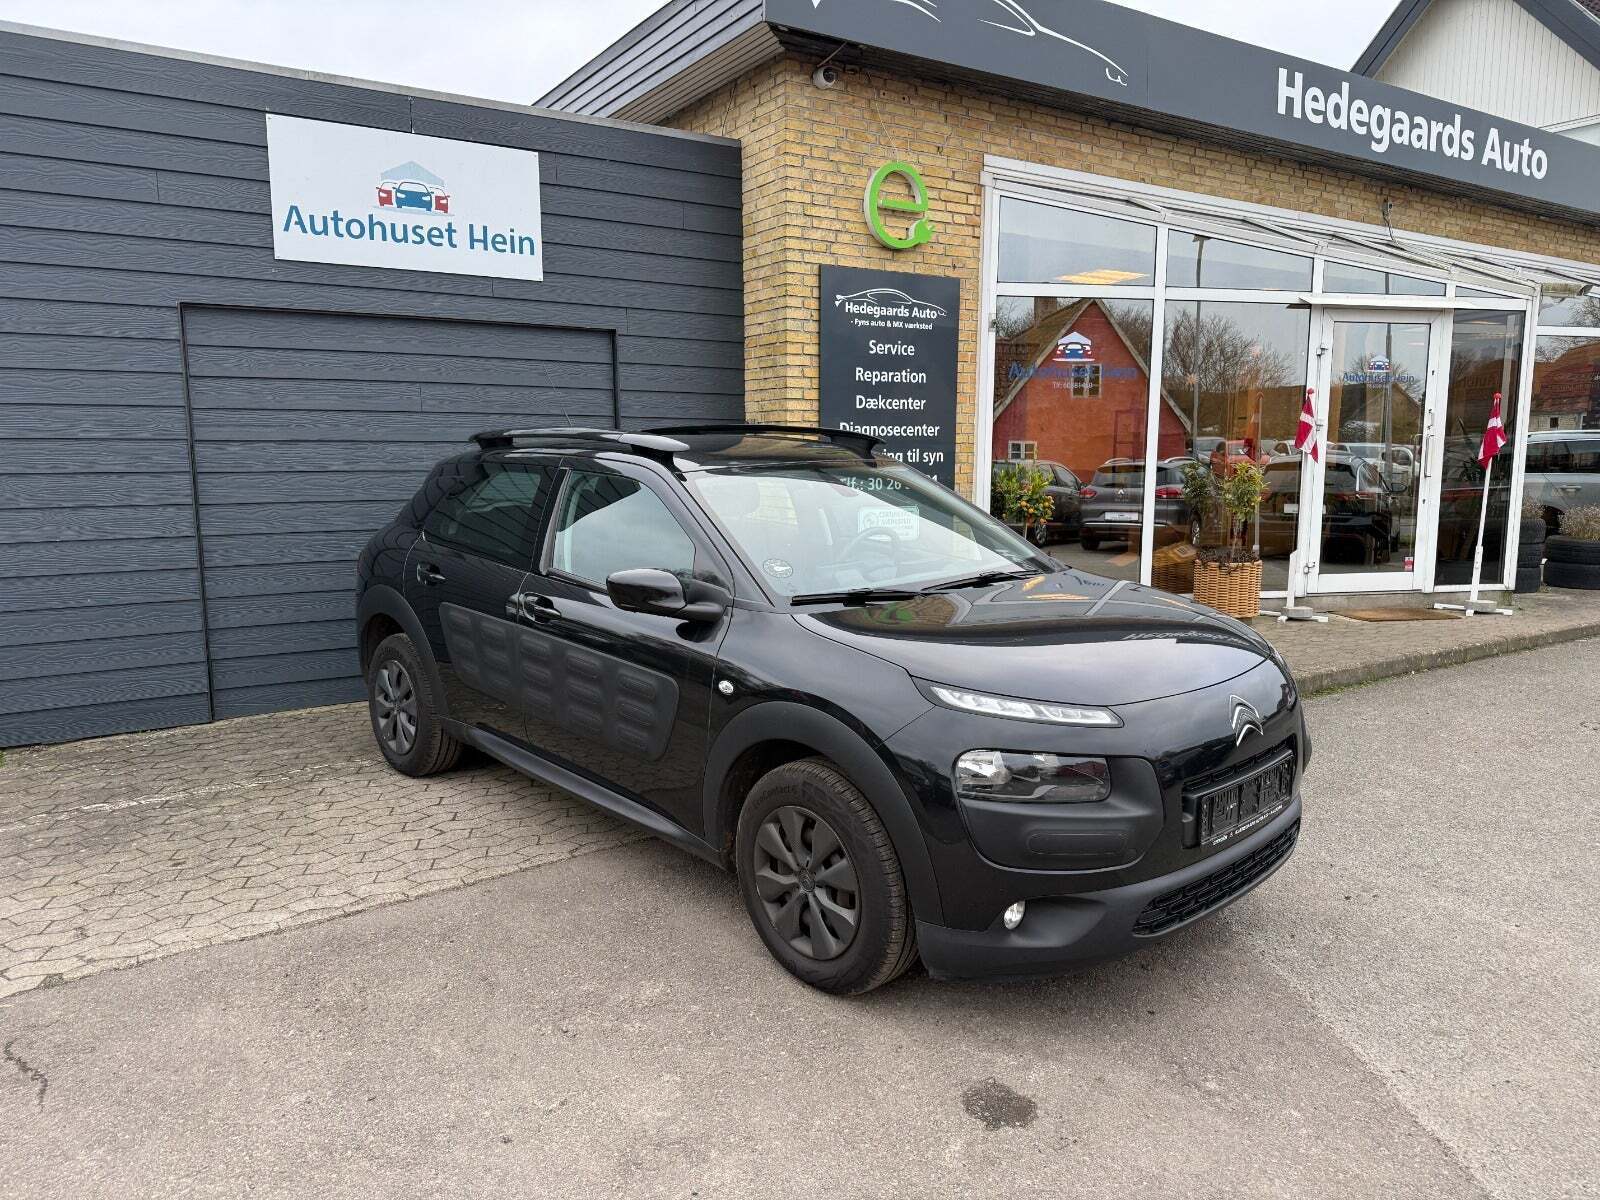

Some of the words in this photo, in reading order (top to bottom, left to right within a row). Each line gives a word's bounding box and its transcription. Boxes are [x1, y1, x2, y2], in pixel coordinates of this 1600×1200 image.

[1277, 66, 1475, 160] Hedegaards
[1481, 127, 1548, 180] Auto
[283, 205, 457, 249] Autohuset
[468, 223, 536, 256] Hein
[845, 301, 910, 318] Hedegaards
[911, 306, 938, 319] Auto
[854, 318, 870, 327] Fyns
[868, 339, 915, 356] Service
[855, 367, 927, 386] Reparation
[856, 395, 926, 410] Dækcenter
[839, 421, 940, 437] Diagnosecenter
[906, 448, 920, 463] til
[923, 452, 943, 466] syn
[868, 477, 883, 490] 30
